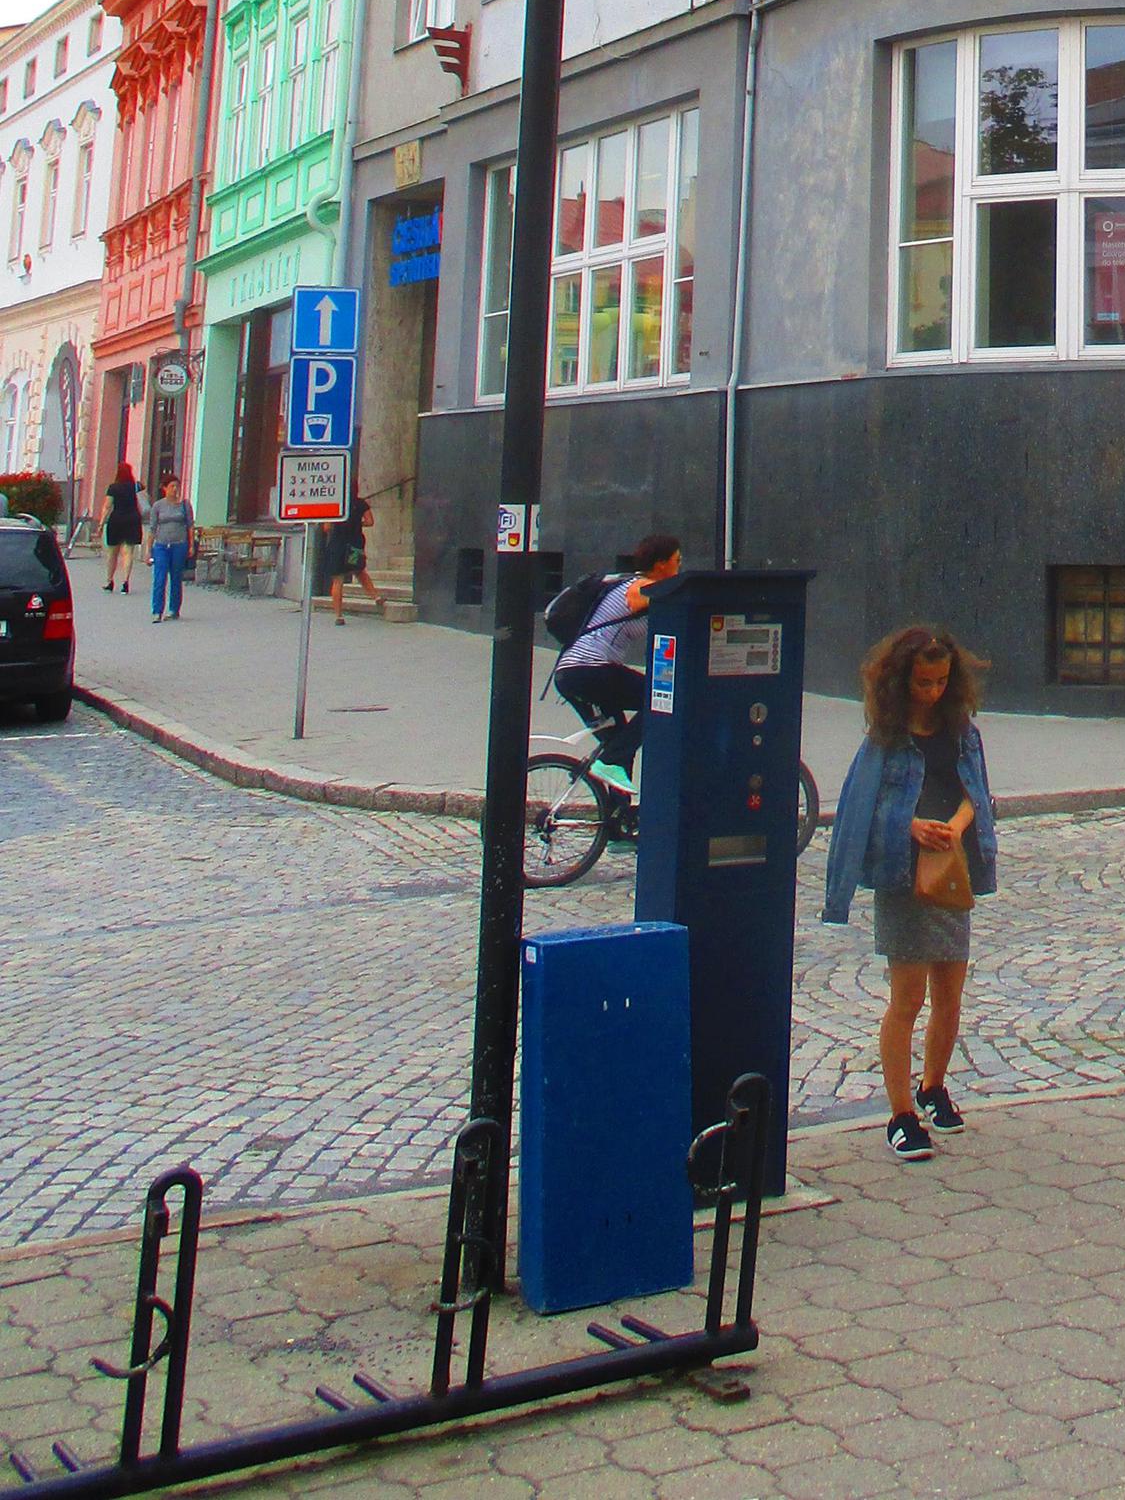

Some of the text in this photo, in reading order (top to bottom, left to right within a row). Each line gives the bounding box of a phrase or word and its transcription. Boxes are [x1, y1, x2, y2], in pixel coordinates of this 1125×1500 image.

[307, 361, 337, 412] P
[297, 462, 330, 471] MIMO
[290, 475, 297, 485] 3
[310, 474, 337, 484] TAXI
[289, 489, 297, 498] 4
